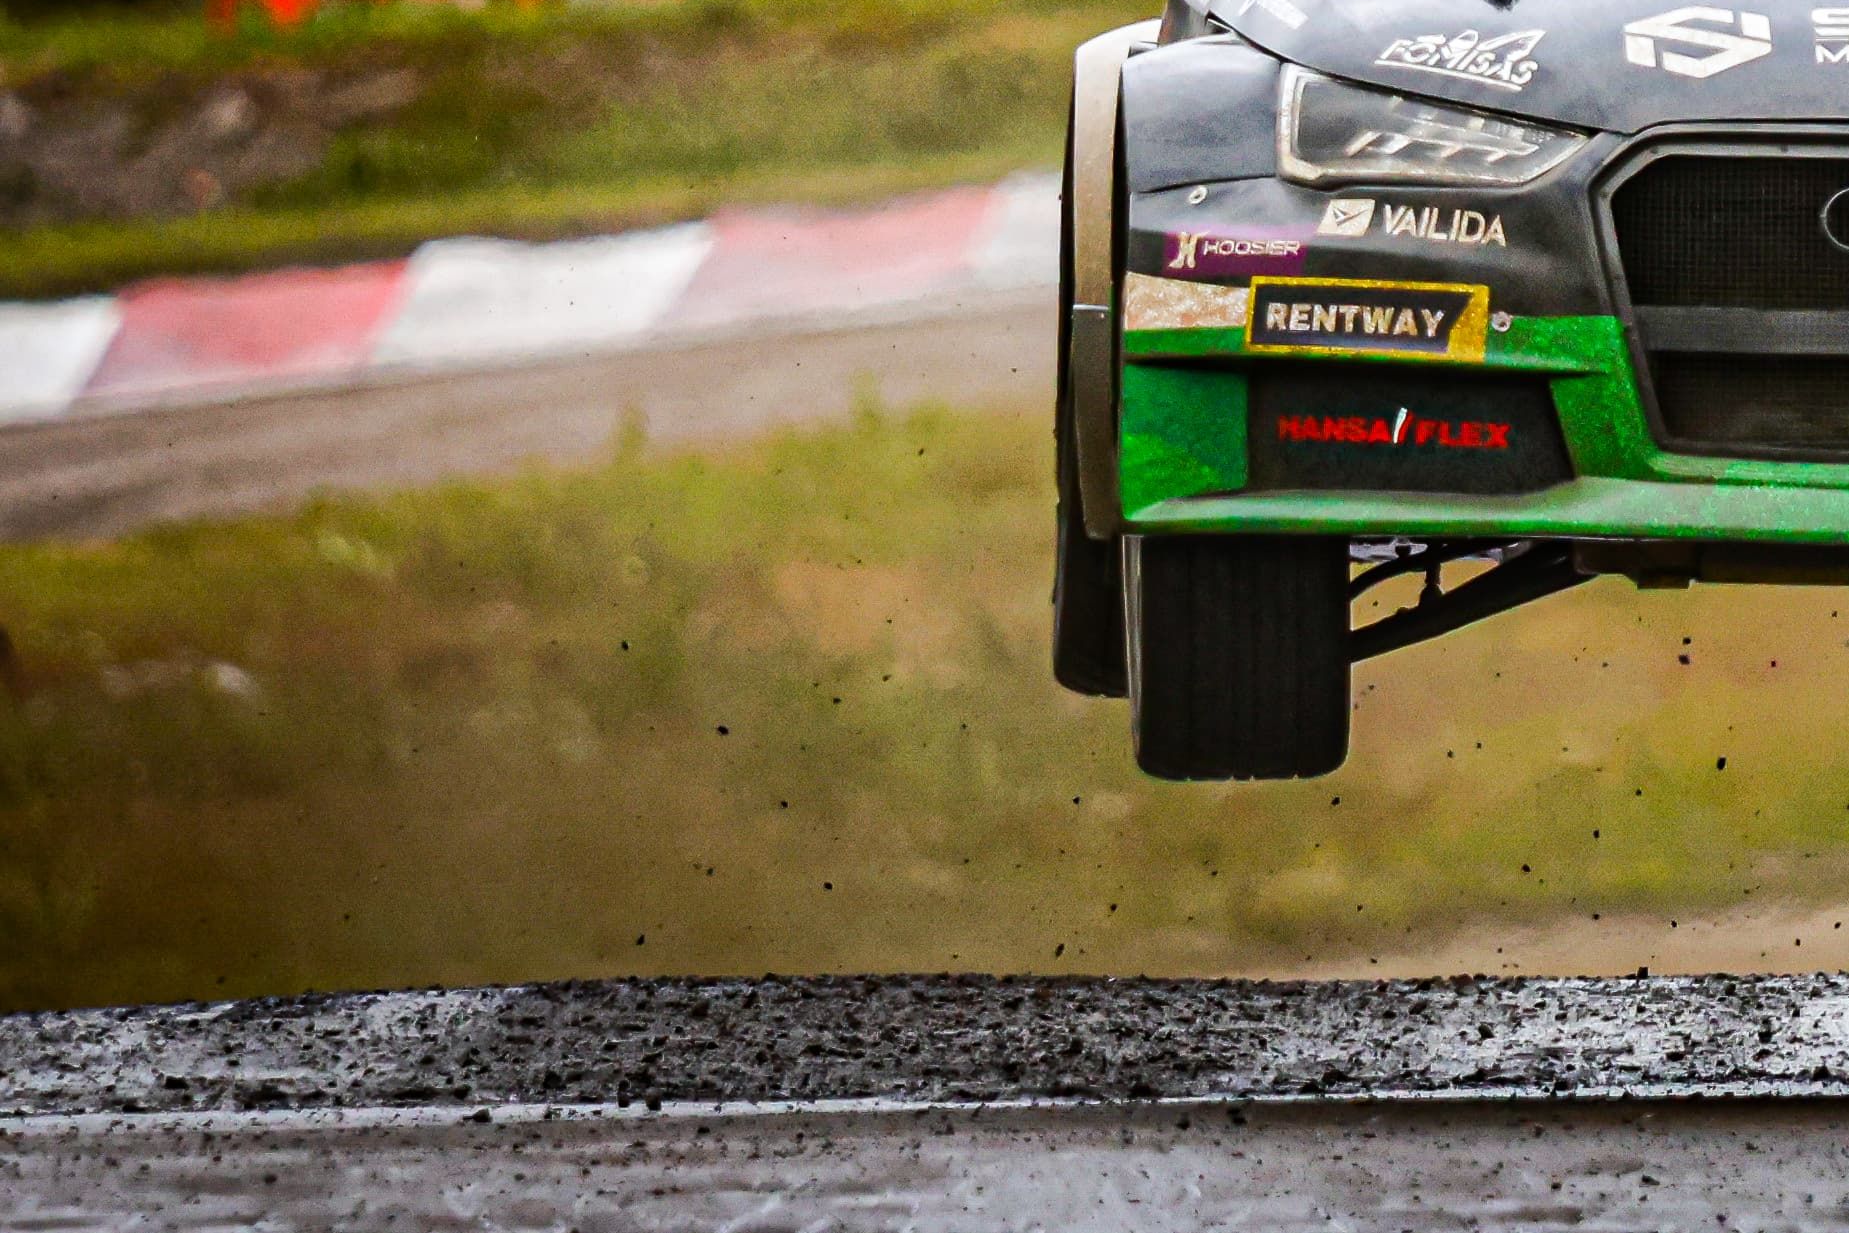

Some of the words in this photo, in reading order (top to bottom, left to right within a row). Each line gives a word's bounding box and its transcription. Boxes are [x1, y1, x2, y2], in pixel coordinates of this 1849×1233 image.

[1383, 205, 1508, 246] VAILIDA
[1203, 239, 1300, 257] HOOSIER
[1266, 301, 1446, 337] RENTWAY
